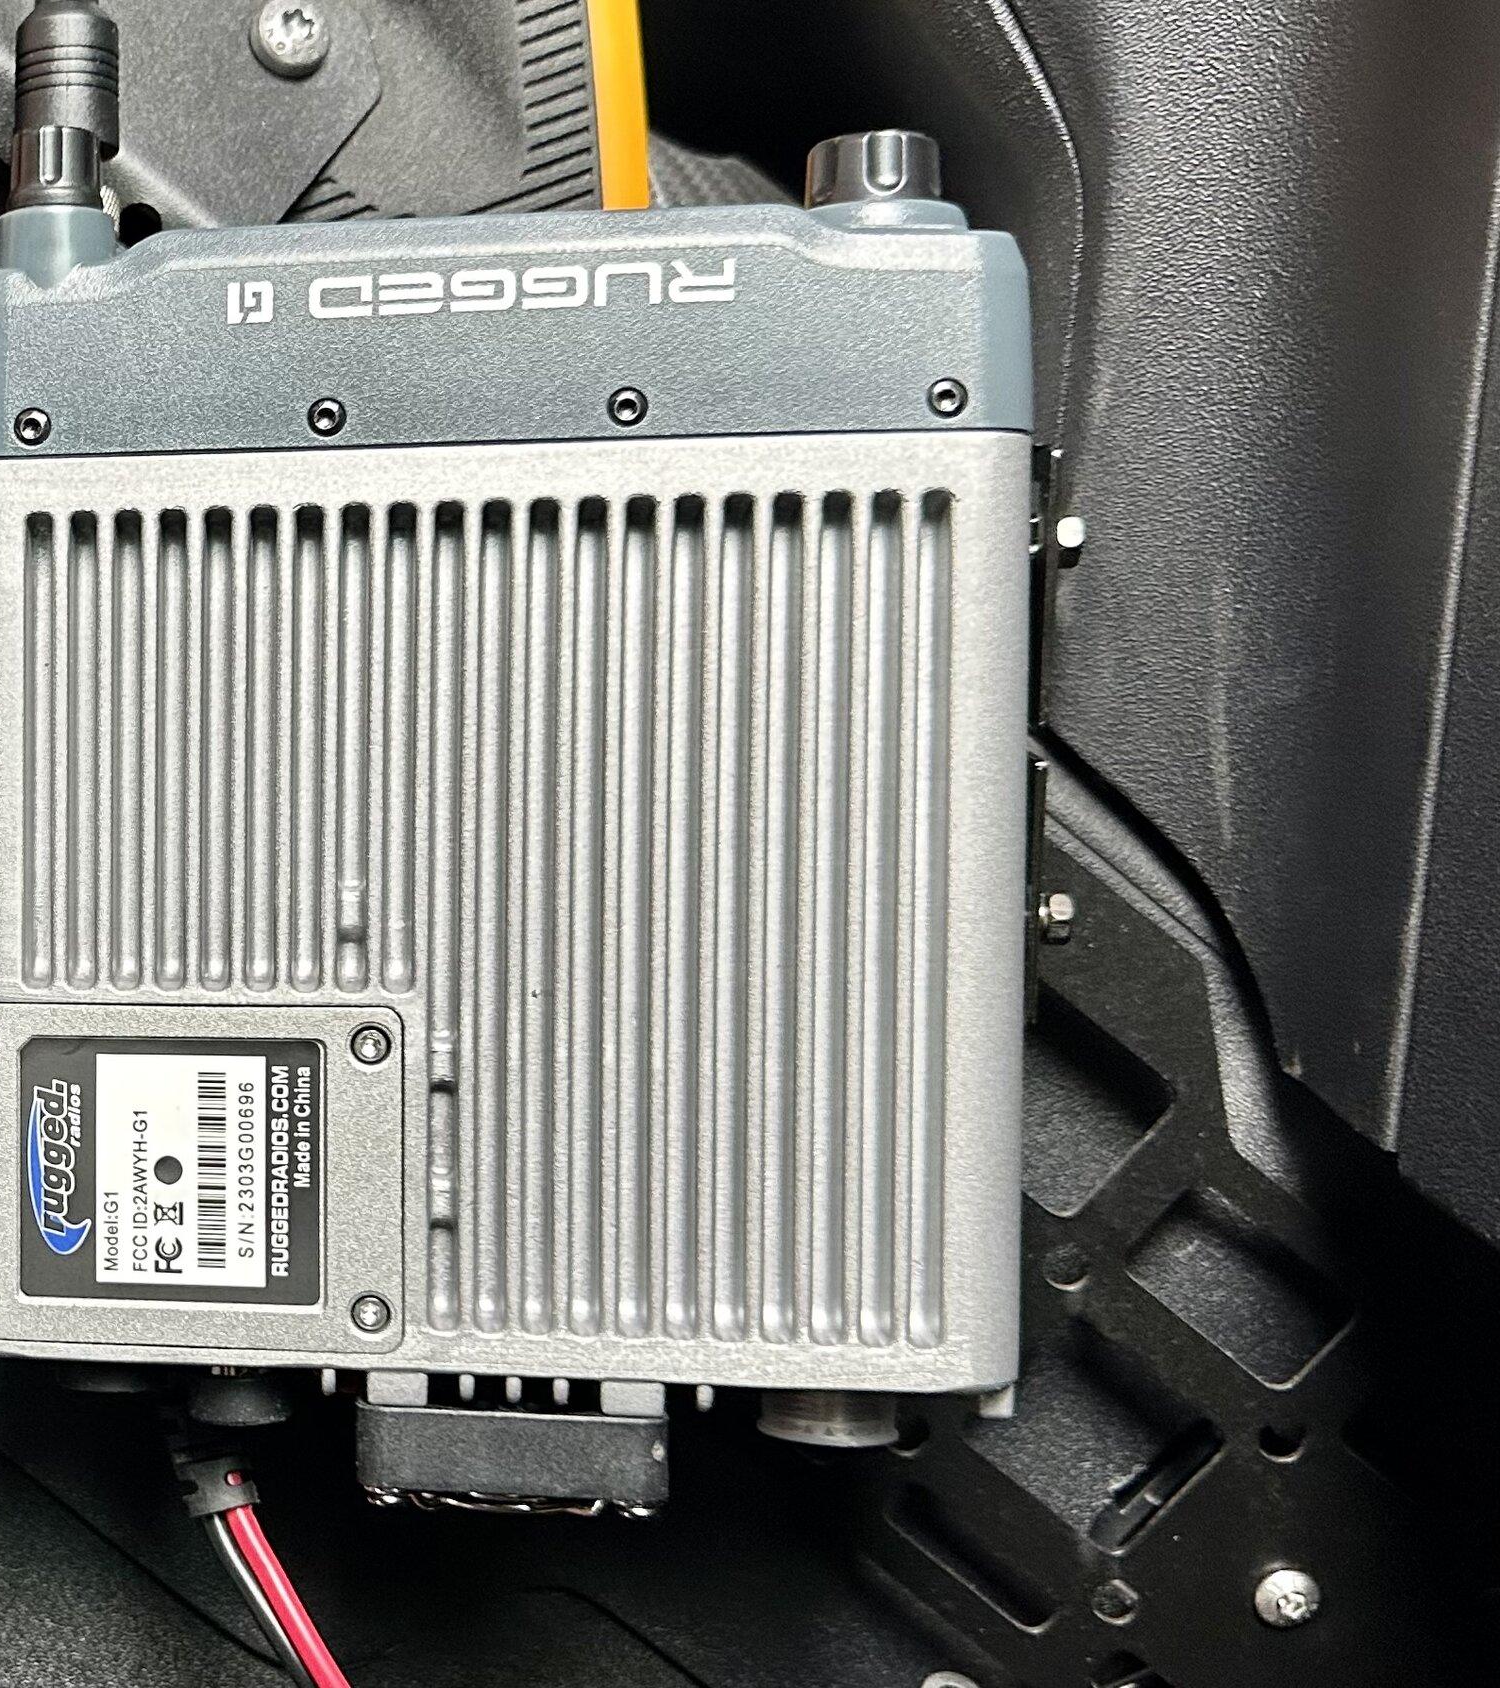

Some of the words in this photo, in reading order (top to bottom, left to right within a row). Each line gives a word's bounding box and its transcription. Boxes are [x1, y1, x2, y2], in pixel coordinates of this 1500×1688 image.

[227, 280, 273, 324] G1
[308, 258, 736, 319] RUGGED
[70, 1083, 81, 1148] radios
[293, 1066, 311, 1117] China
[293, 1120, 311, 1138] in
[132, 1109, 148, 1235] ID:2AWYH-G1
[271, 1065, 289, 1277] RUGGEDRADIOS.COM
[293, 1142, 311, 1188] Made
[103, 1191, 119, 1271] Model:G1
[132, 1239, 148, 1272] FCC
